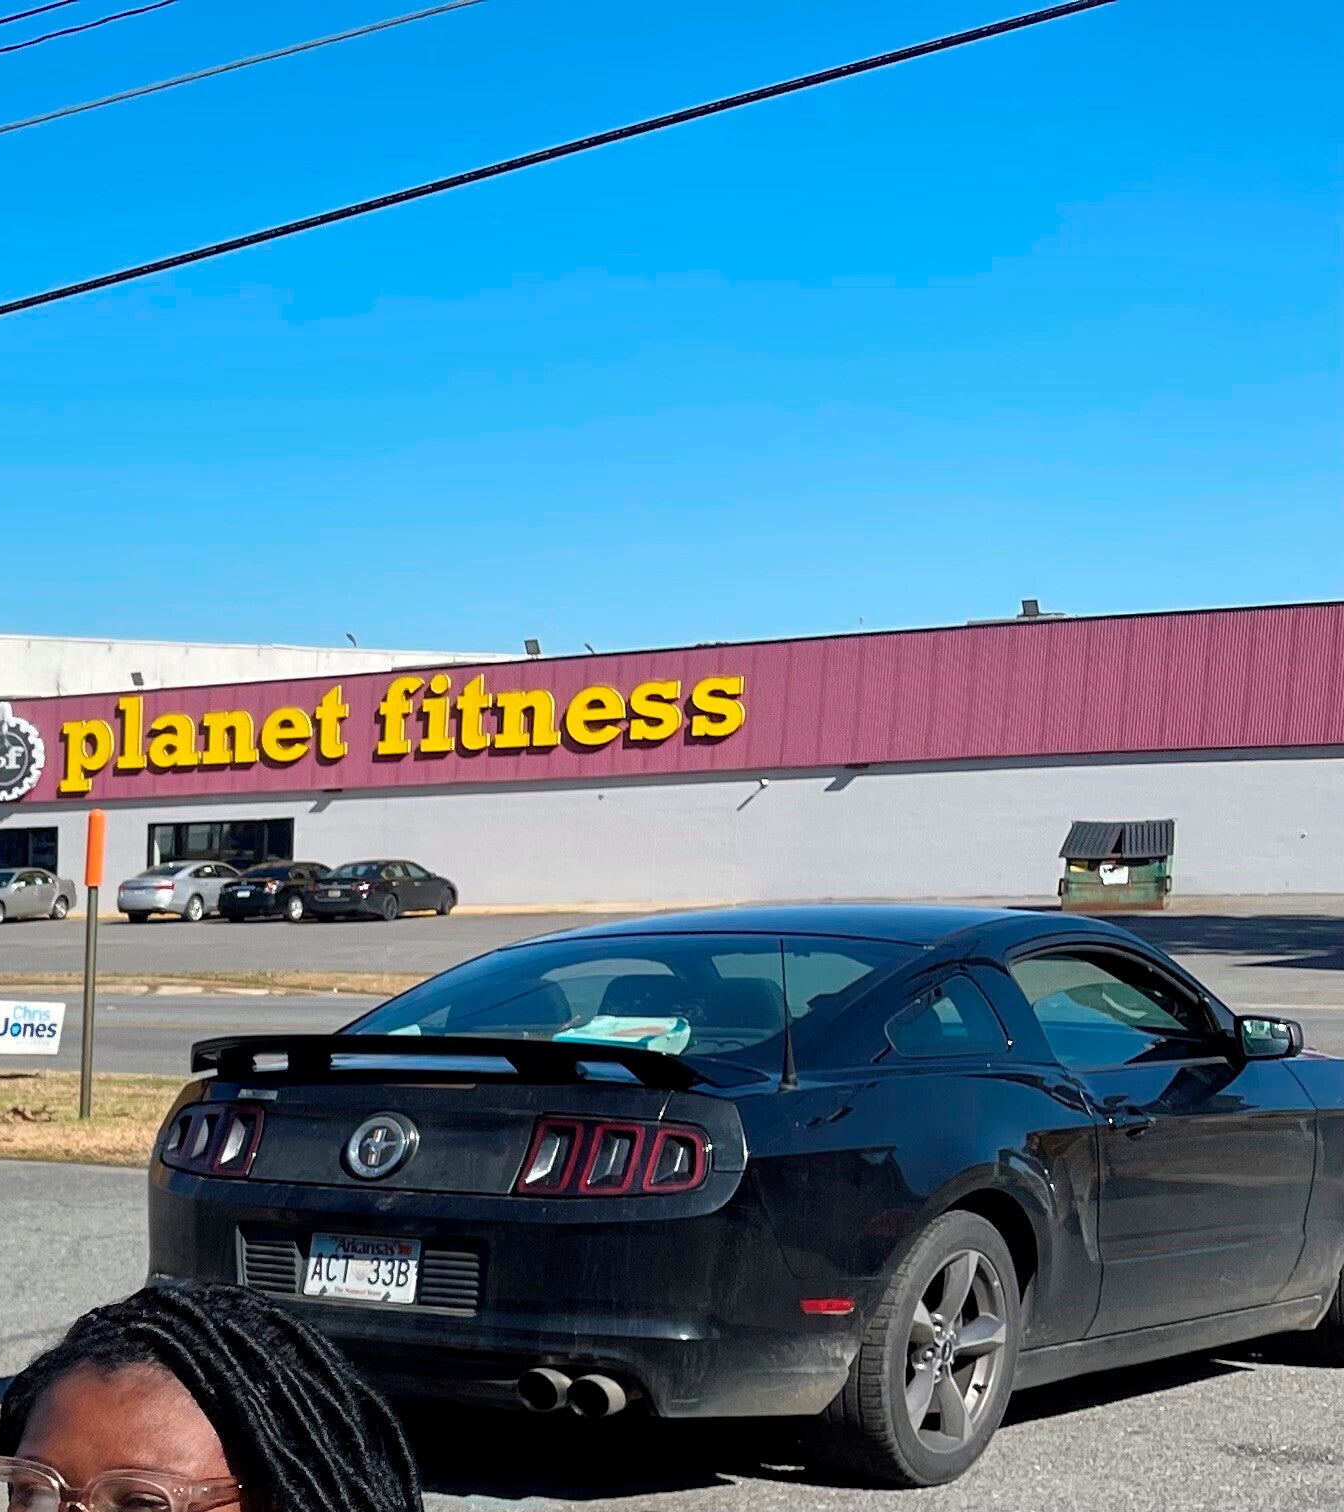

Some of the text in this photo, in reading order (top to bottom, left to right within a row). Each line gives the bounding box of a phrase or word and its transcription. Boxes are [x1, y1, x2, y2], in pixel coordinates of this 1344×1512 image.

[60, 673, 746, 793] planet fitness
[13, 1005, 51, 1021] Chris
[310, 1252, 411, 1287] ACT 33B
